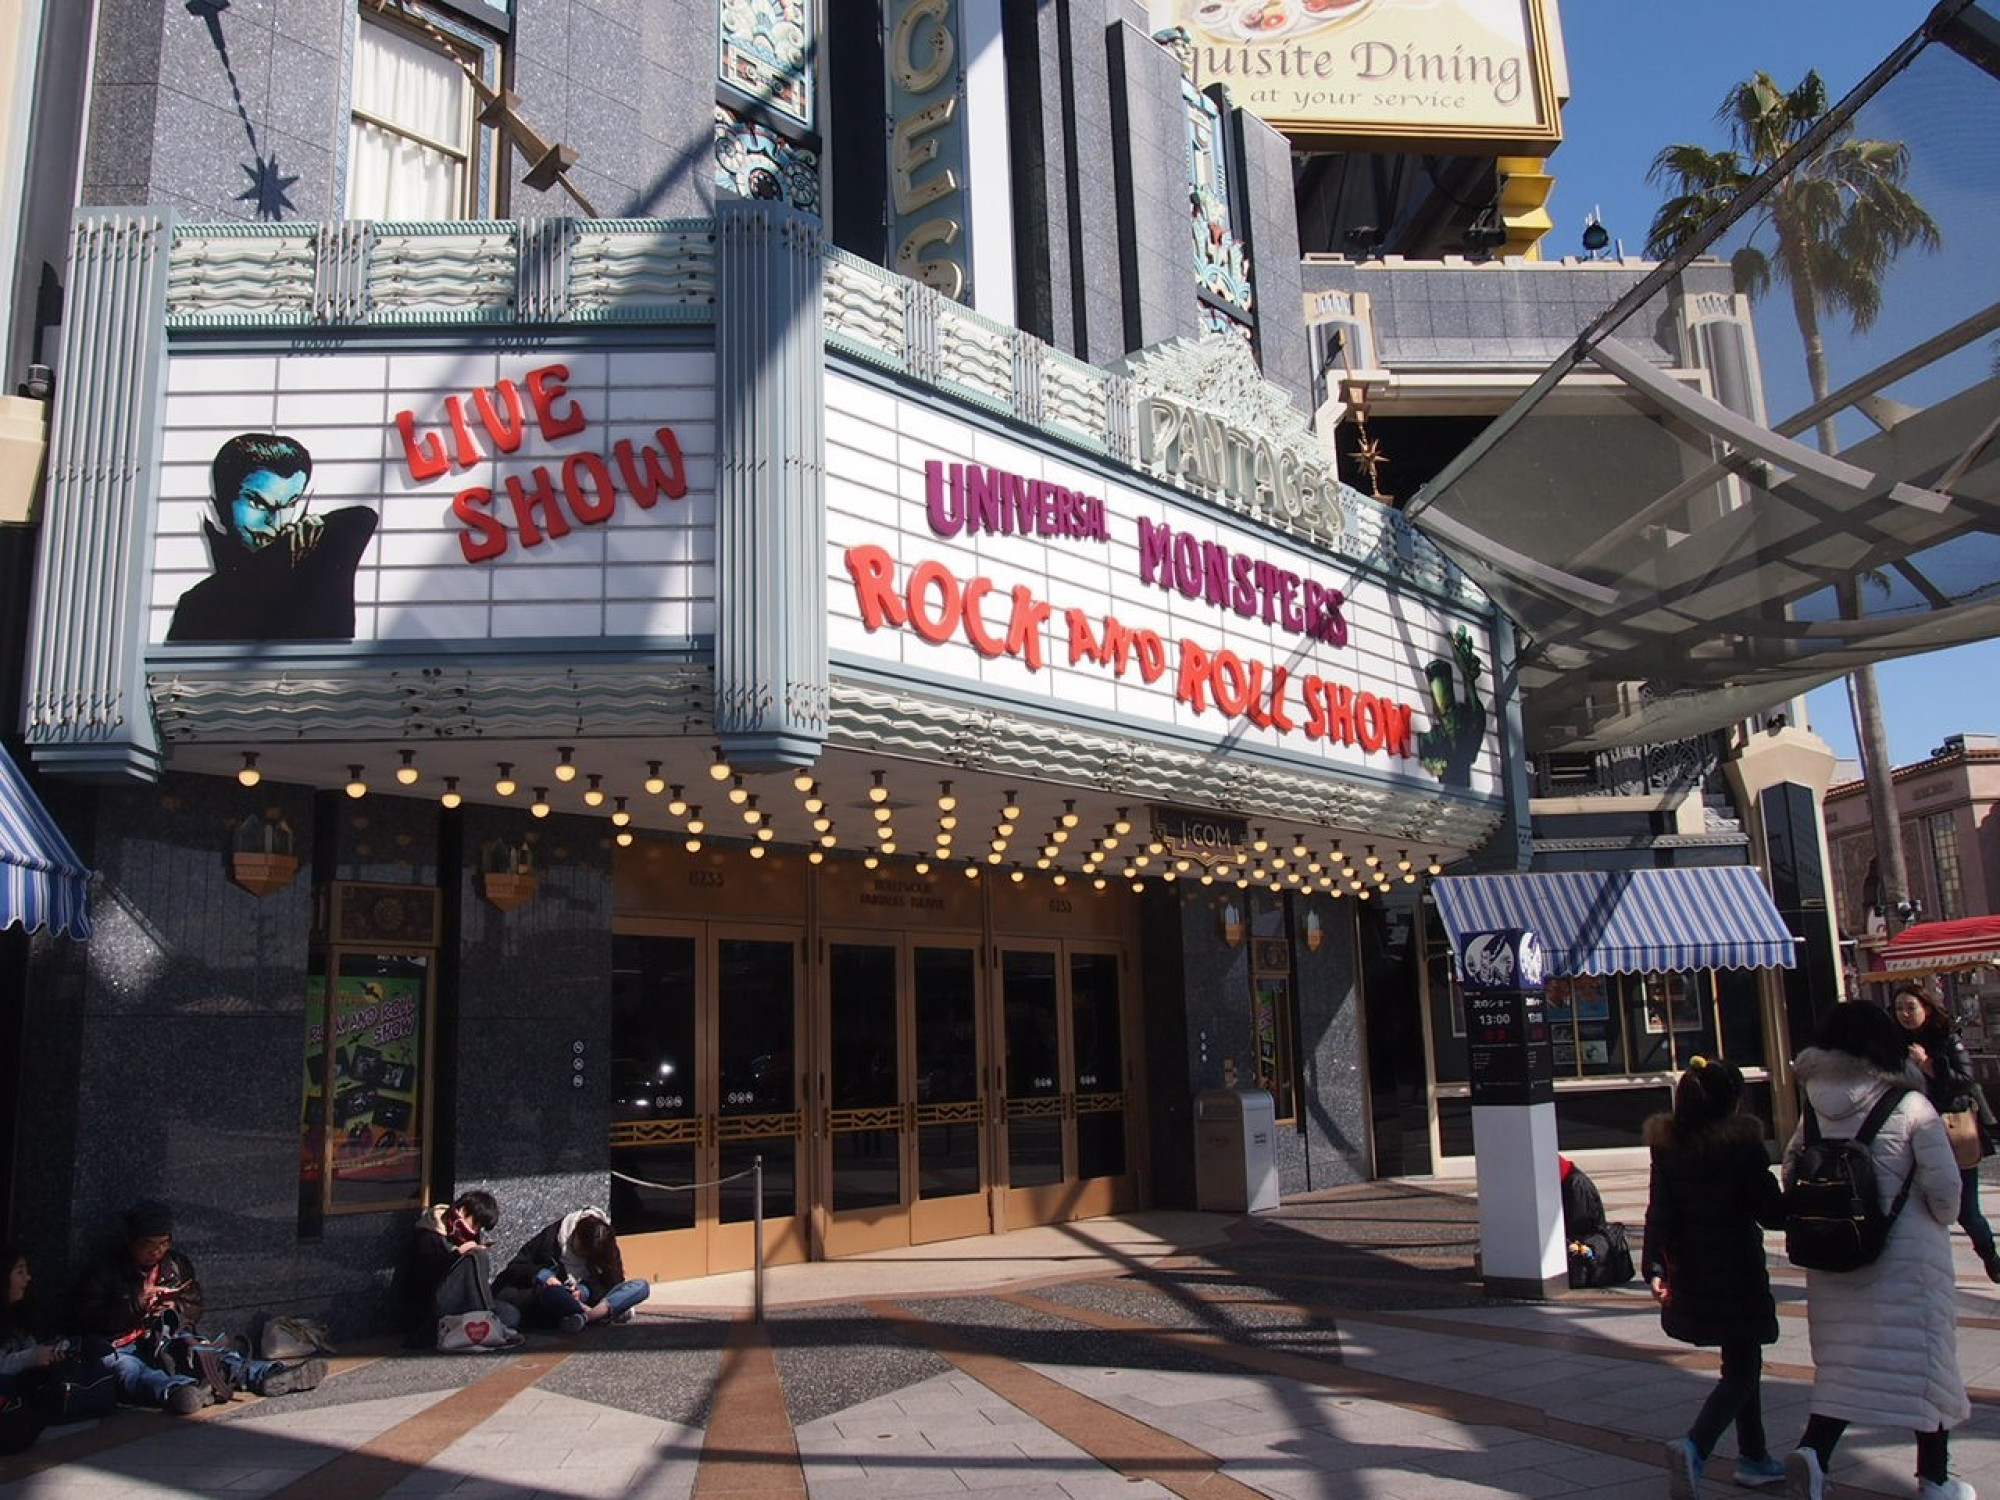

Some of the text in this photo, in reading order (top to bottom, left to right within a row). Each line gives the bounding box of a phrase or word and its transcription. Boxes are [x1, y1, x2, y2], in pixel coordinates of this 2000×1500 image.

[1250, 87, 1466, 115] at your service
[1351, 41, 1521, 106] Dining
[396, 364, 586, 481] LIVE
[1138, 397, 1346, 538] PANTAGES
[453, 427, 687, 563] SHOW
[925, 460, 1348, 648] UNIVERSAL MONSTERS
[844, 544, 1413, 760] ROCK AND ROLL SHOW
[1479, 1013, 1510, 1026] 13:00
